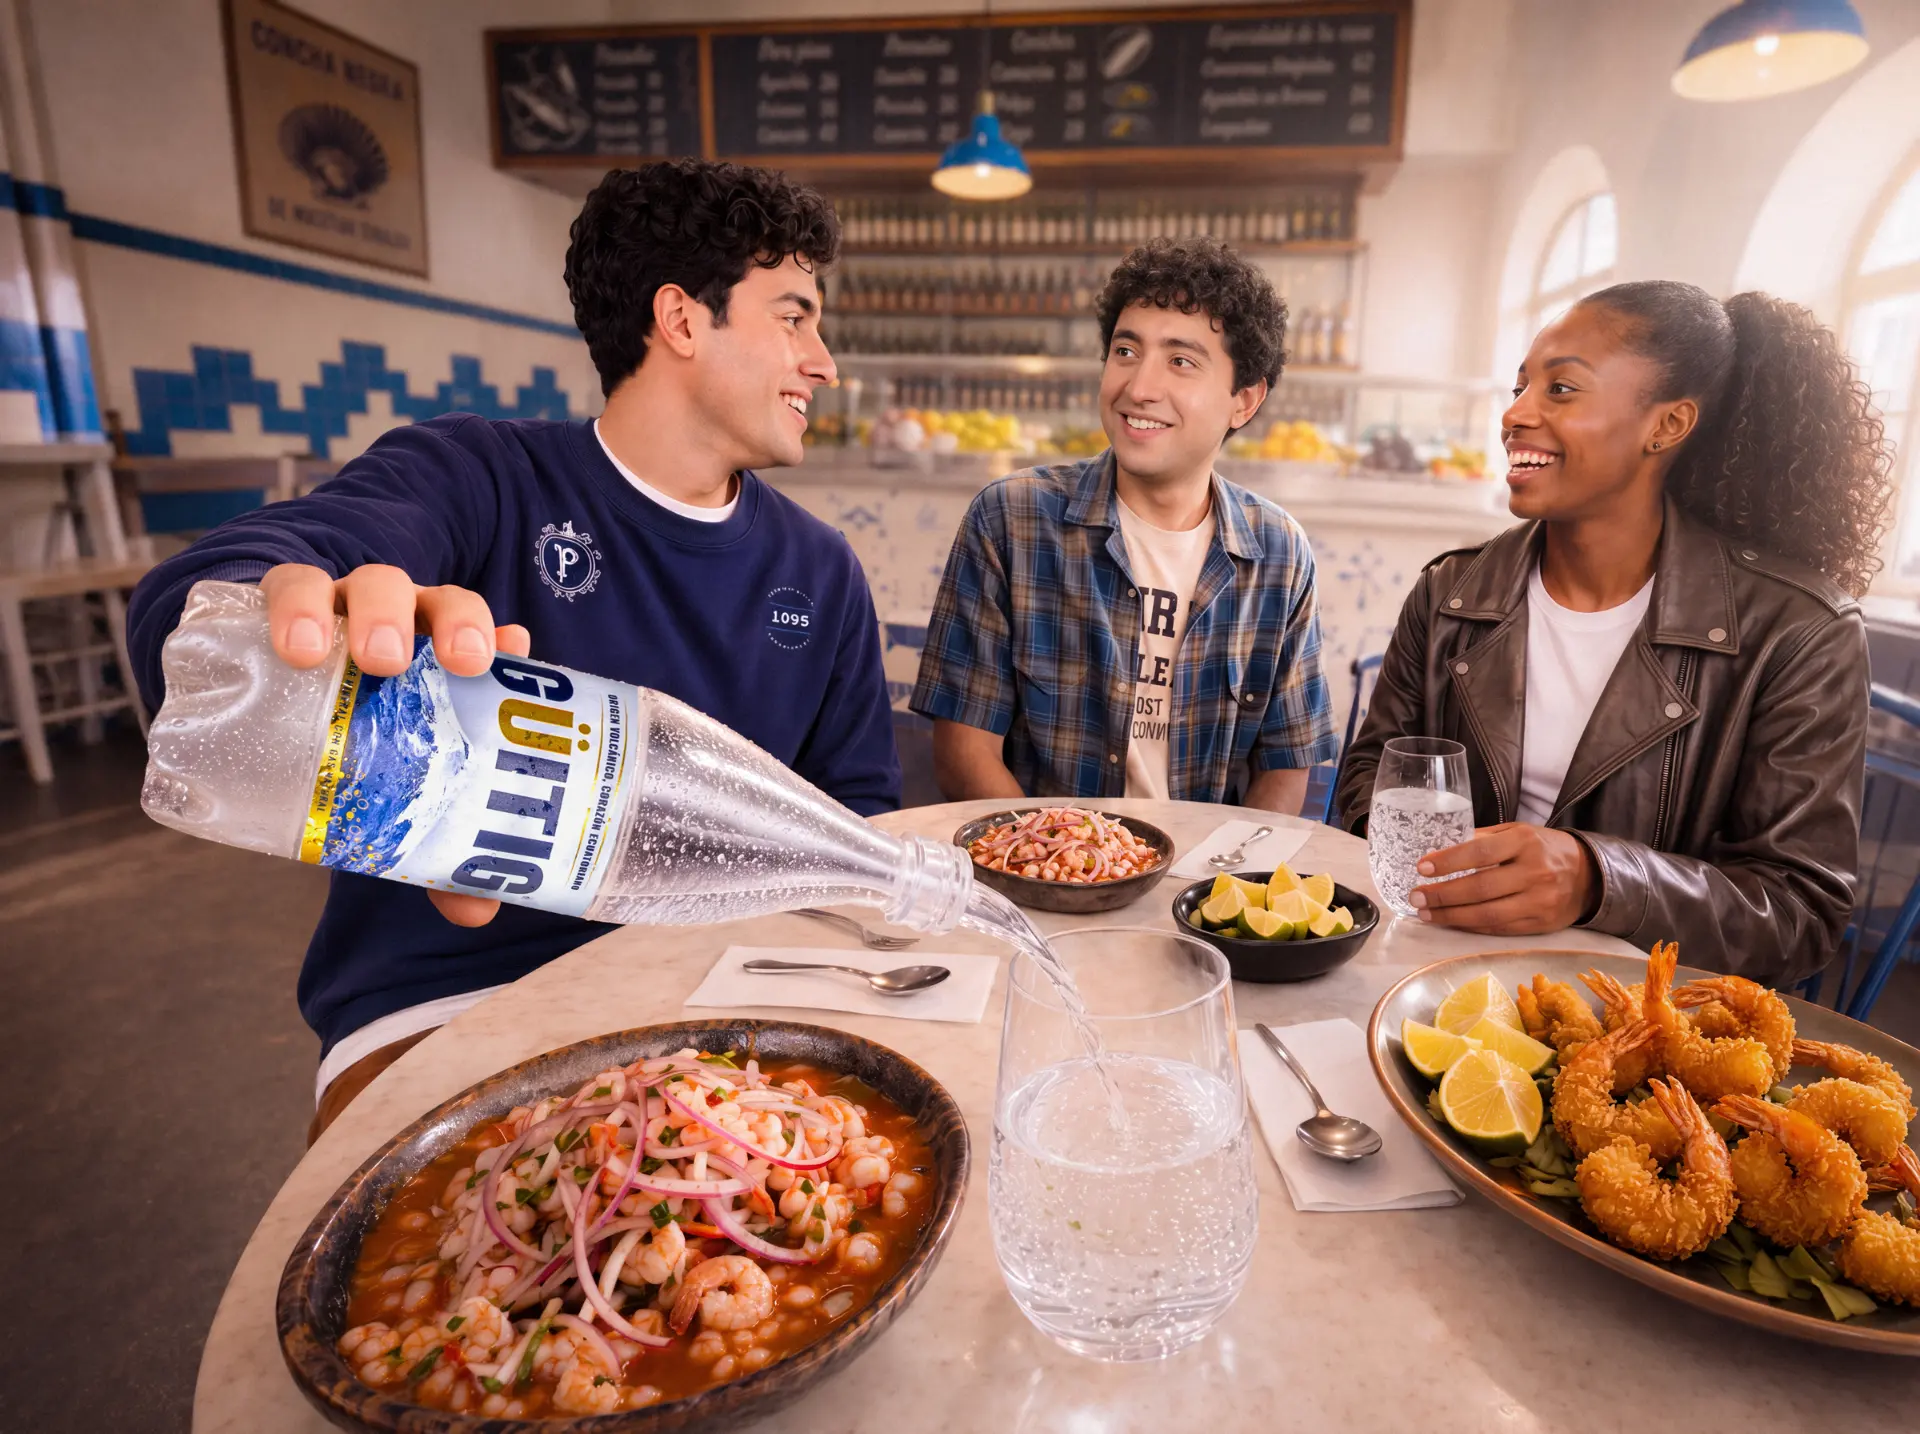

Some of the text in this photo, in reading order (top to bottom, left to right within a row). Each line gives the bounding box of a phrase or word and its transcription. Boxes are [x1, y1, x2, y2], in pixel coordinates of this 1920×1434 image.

[772, 610, 810, 627] 1095
[1137, 653, 1173, 688] LE
[1136, 696, 1163, 716] OST
[331, 724, 343, 746] CON
[327, 749, 339, 768] GAS
[451, 656, 592, 895] GÜITIG
[571, 694, 620, 890] ORIGEN VOLCÁNICO, CORAZÓN ECUATORIANO
